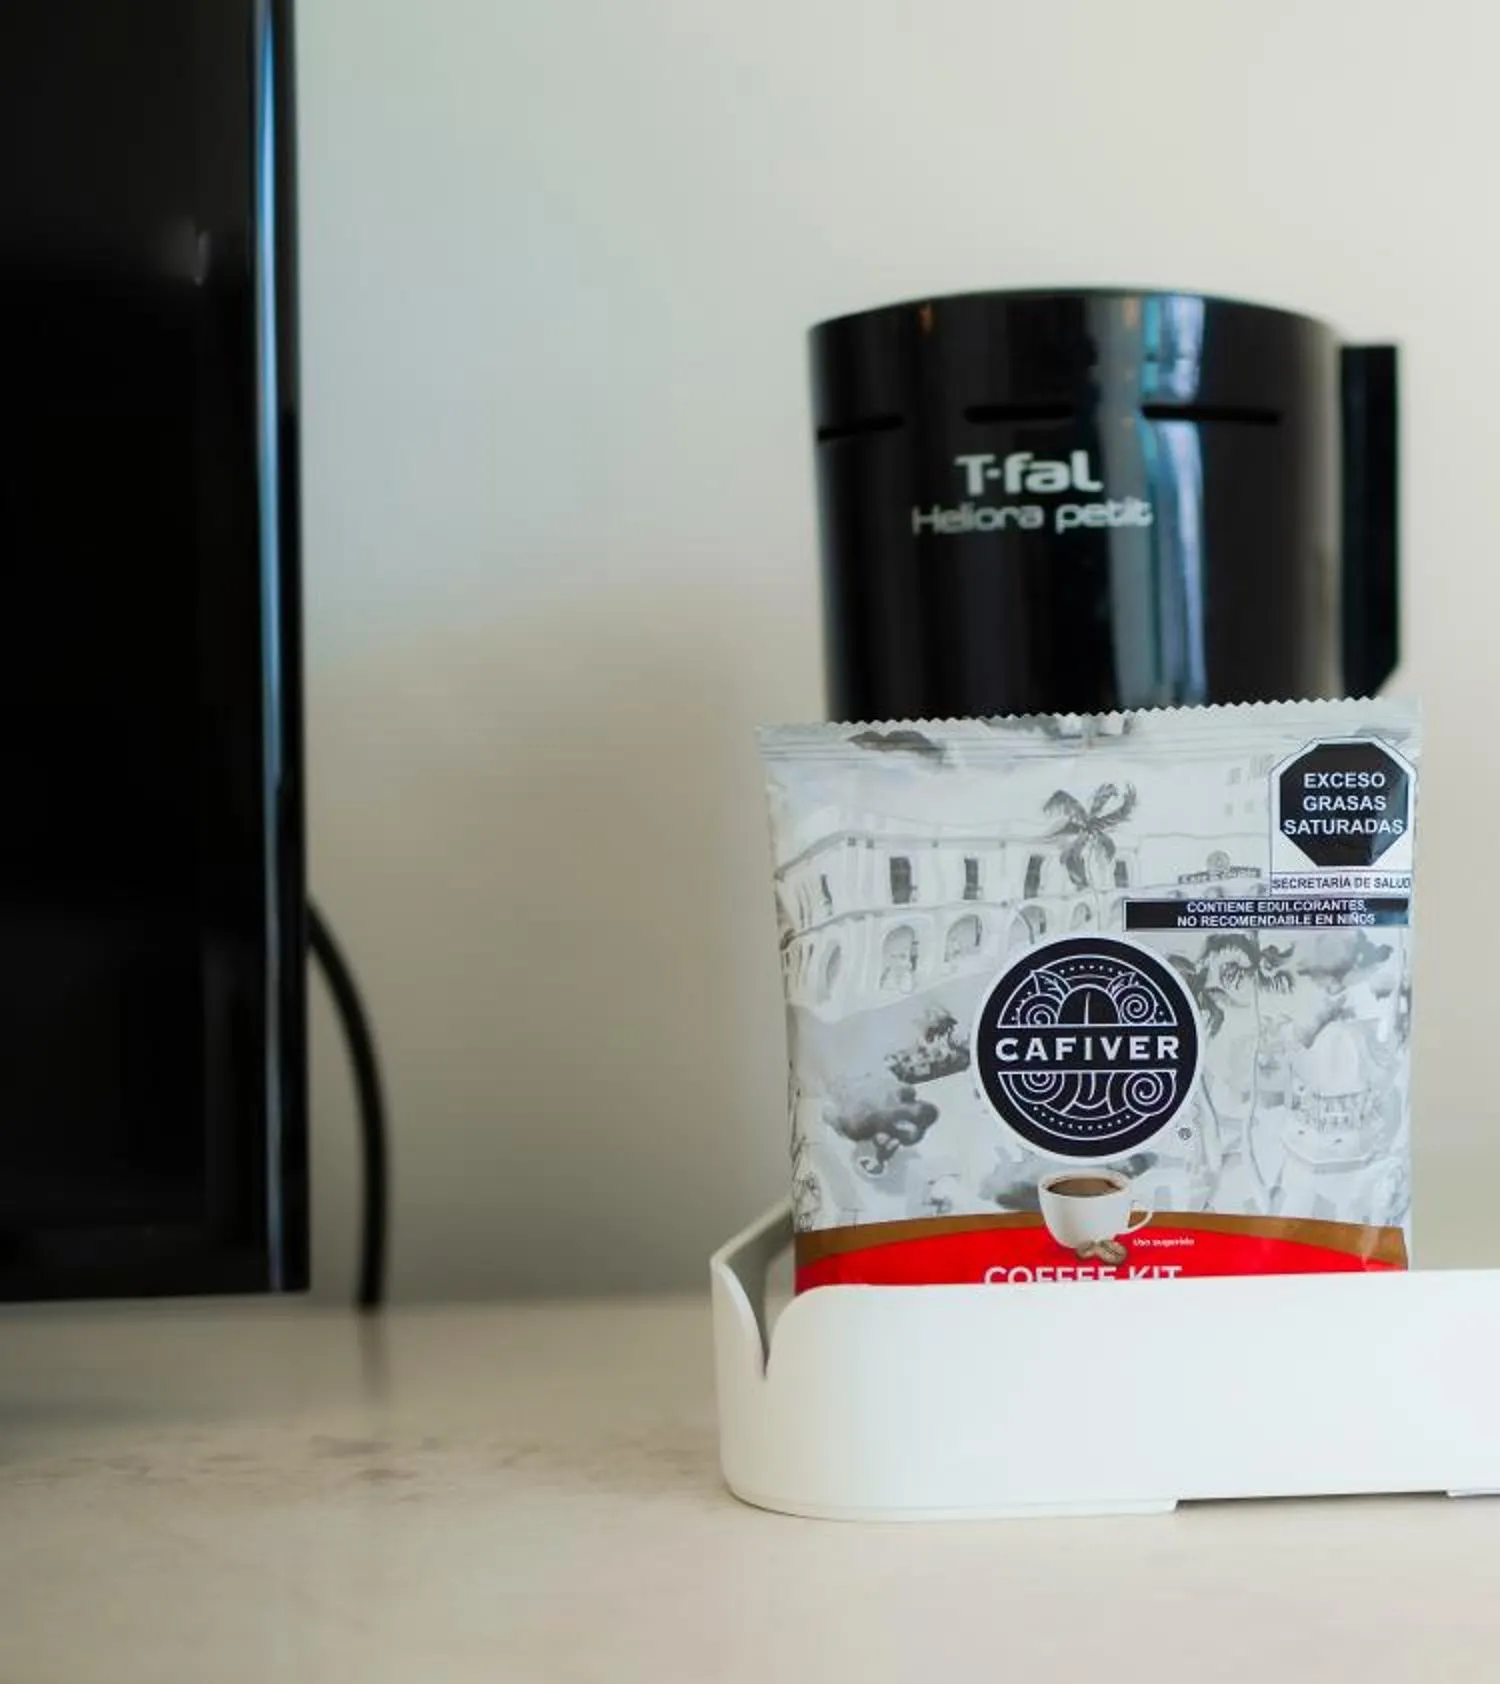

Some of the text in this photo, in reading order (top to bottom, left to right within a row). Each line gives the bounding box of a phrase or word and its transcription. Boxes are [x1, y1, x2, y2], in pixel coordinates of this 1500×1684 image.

[912, 497, 1153, 534] Heliora petit
[1303, 772, 1386, 789] EXCESO
[1302, 795, 1387, 811] GRASAS
[1283, 819, 1404, 835] SATURADAS
[1272, 874, 1351, 889] SECRETARÍA
[1354, 877, 1371, 888] DE
[1374, 877, 1411, 889] SALUD
[1187, 901, 1254, 913] CONTIENE
[1177, 911, 1375, 927] NO RECOMENDABLE EN NIÑOS
[994, 1035, 1180, 1062] CAFIVER
